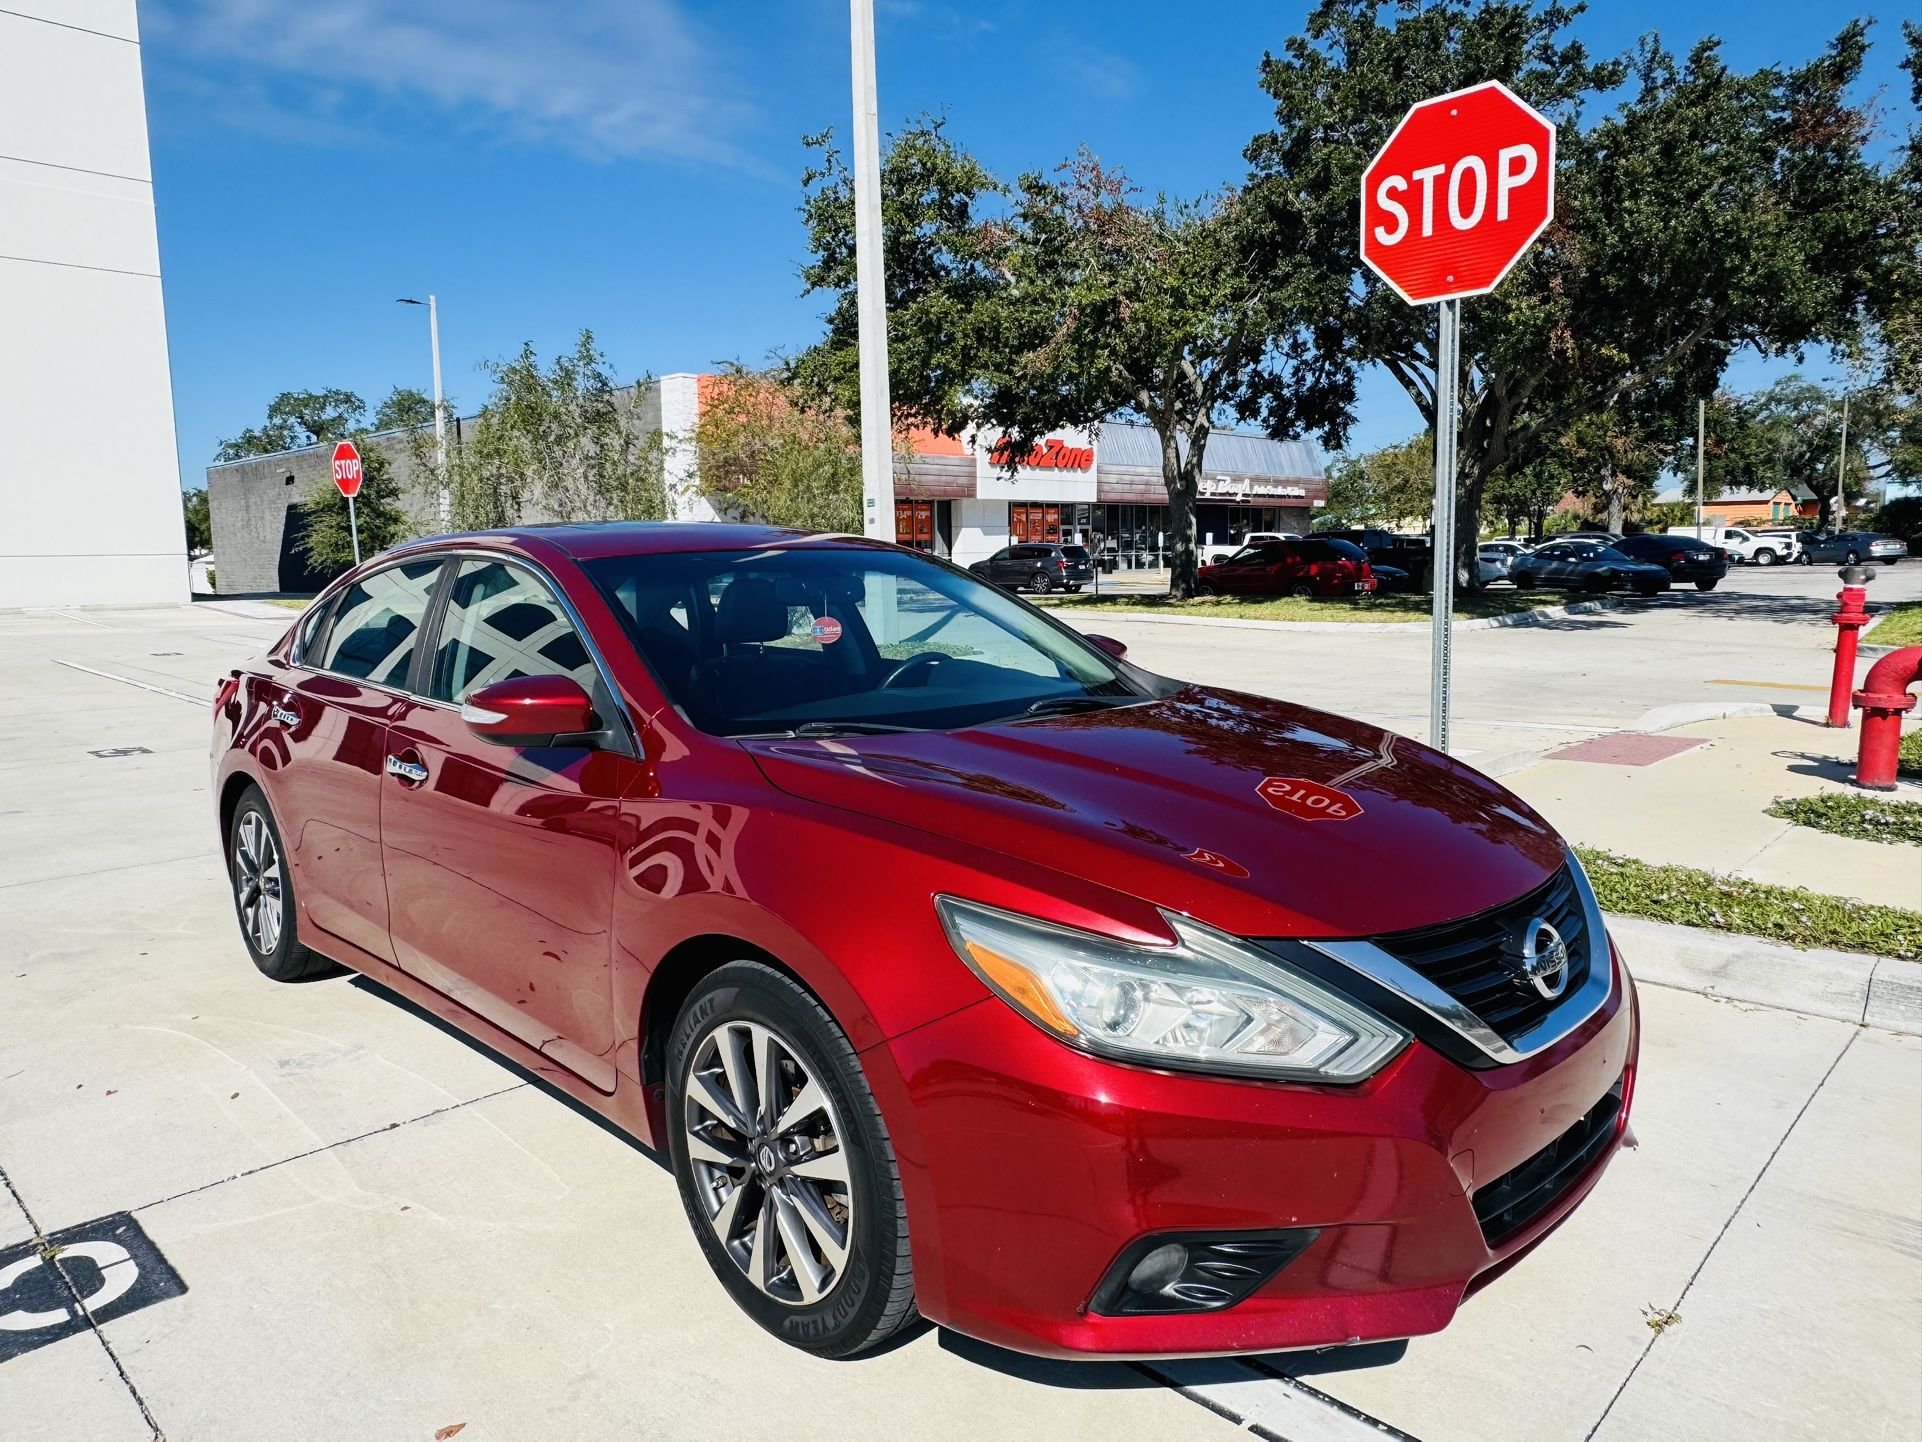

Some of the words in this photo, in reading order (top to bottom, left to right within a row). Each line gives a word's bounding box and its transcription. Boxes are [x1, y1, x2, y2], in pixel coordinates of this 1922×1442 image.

[1374, 143, 1538, 246] STOP
[989, 434, 1093, 468] AoZone
[335, 459, 359, 480] STOP
